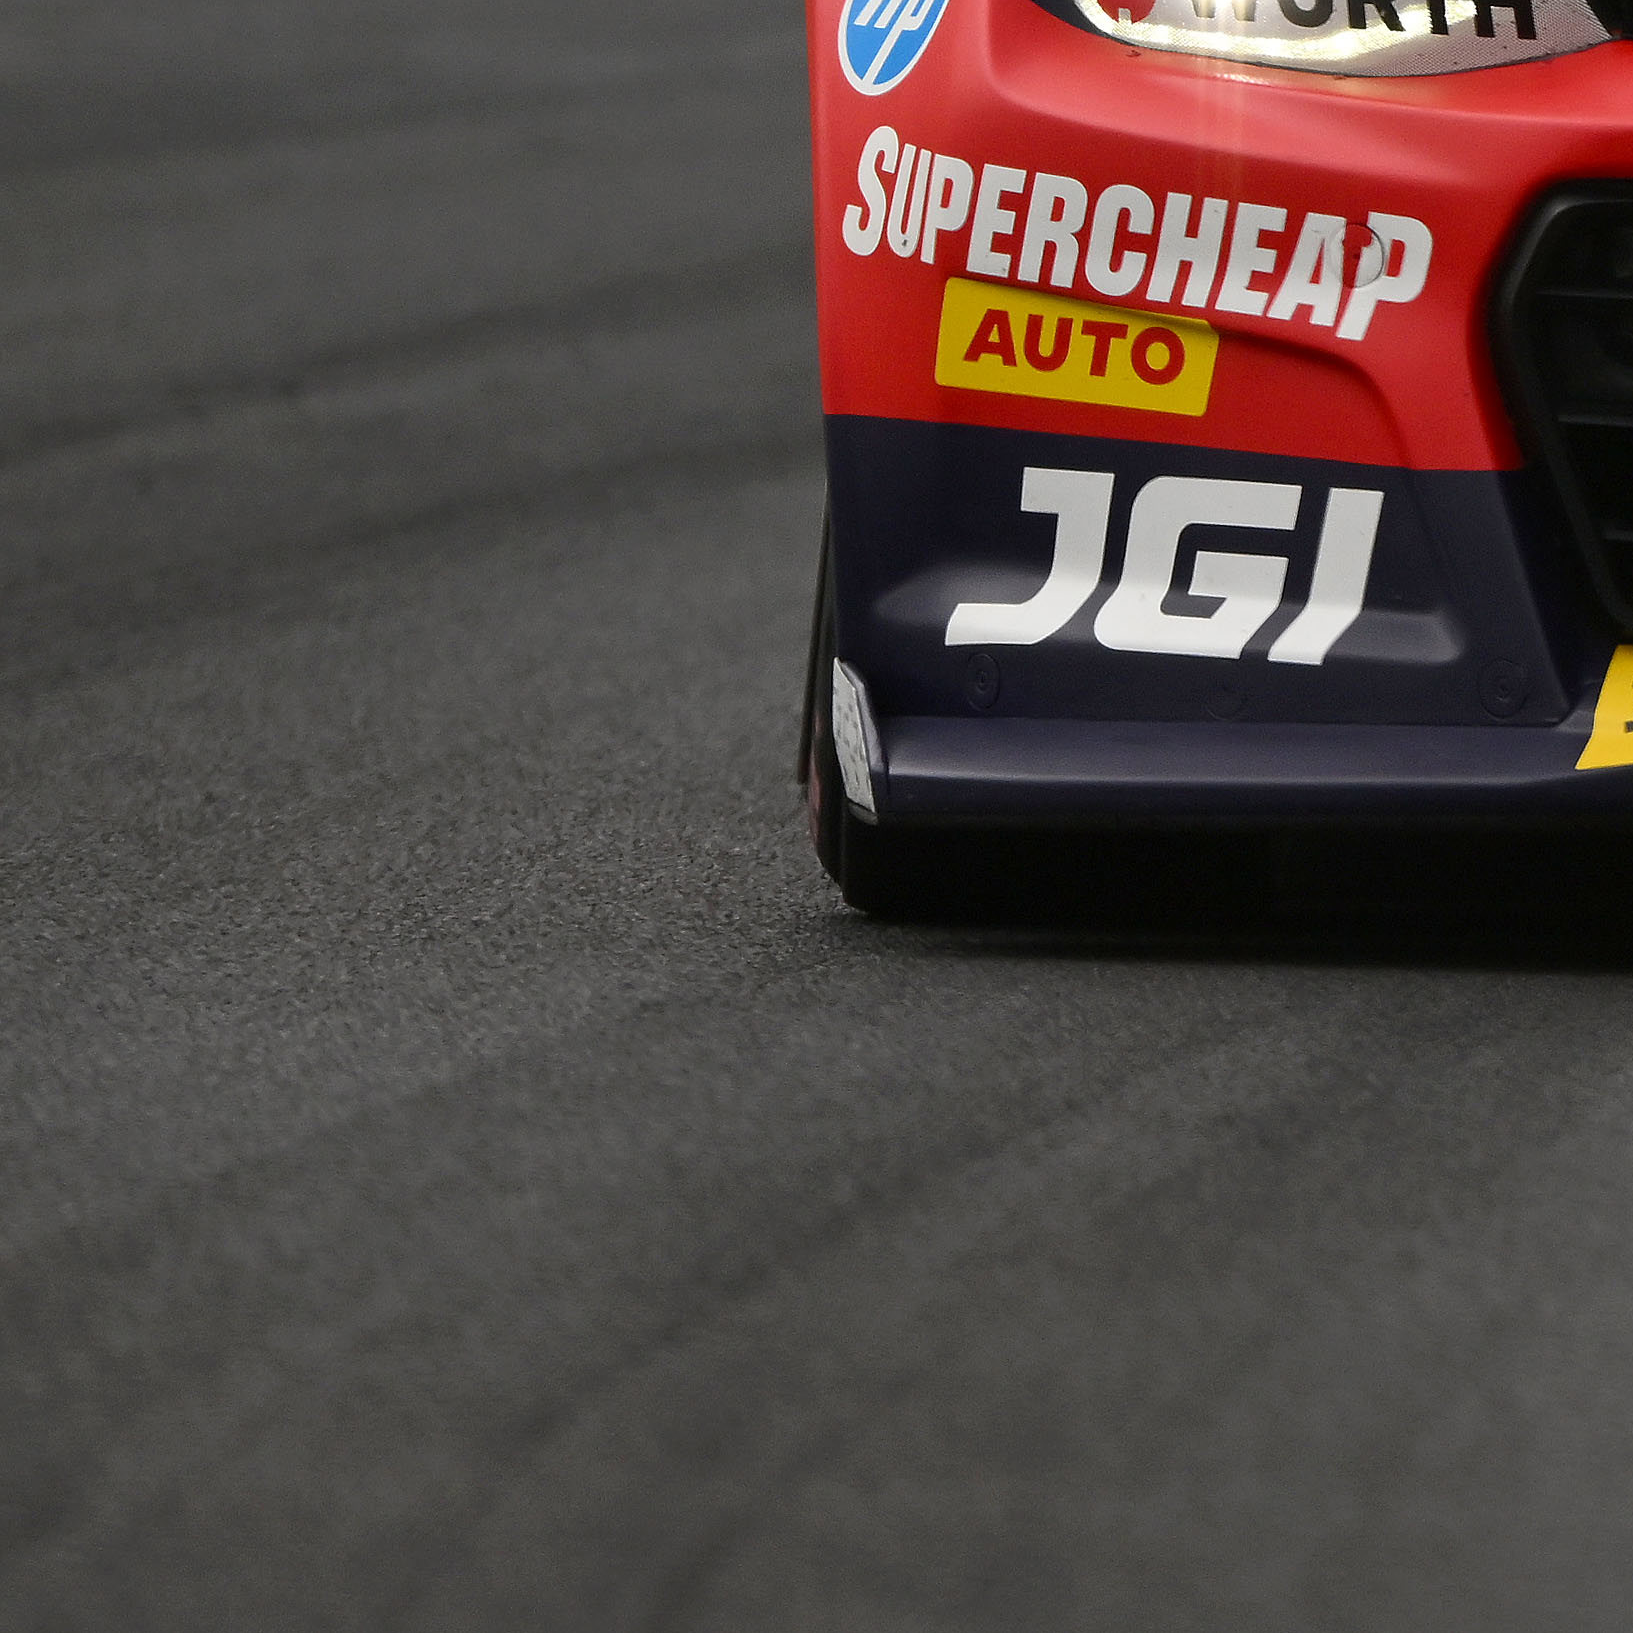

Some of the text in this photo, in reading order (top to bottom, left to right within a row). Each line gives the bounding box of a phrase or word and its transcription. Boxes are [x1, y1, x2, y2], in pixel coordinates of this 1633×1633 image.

[842, 125, 1433, 341] SUPERCHEAP
[963, 308, 1186, 386] AUTO
[945, 467, 1385, 666] JGI
